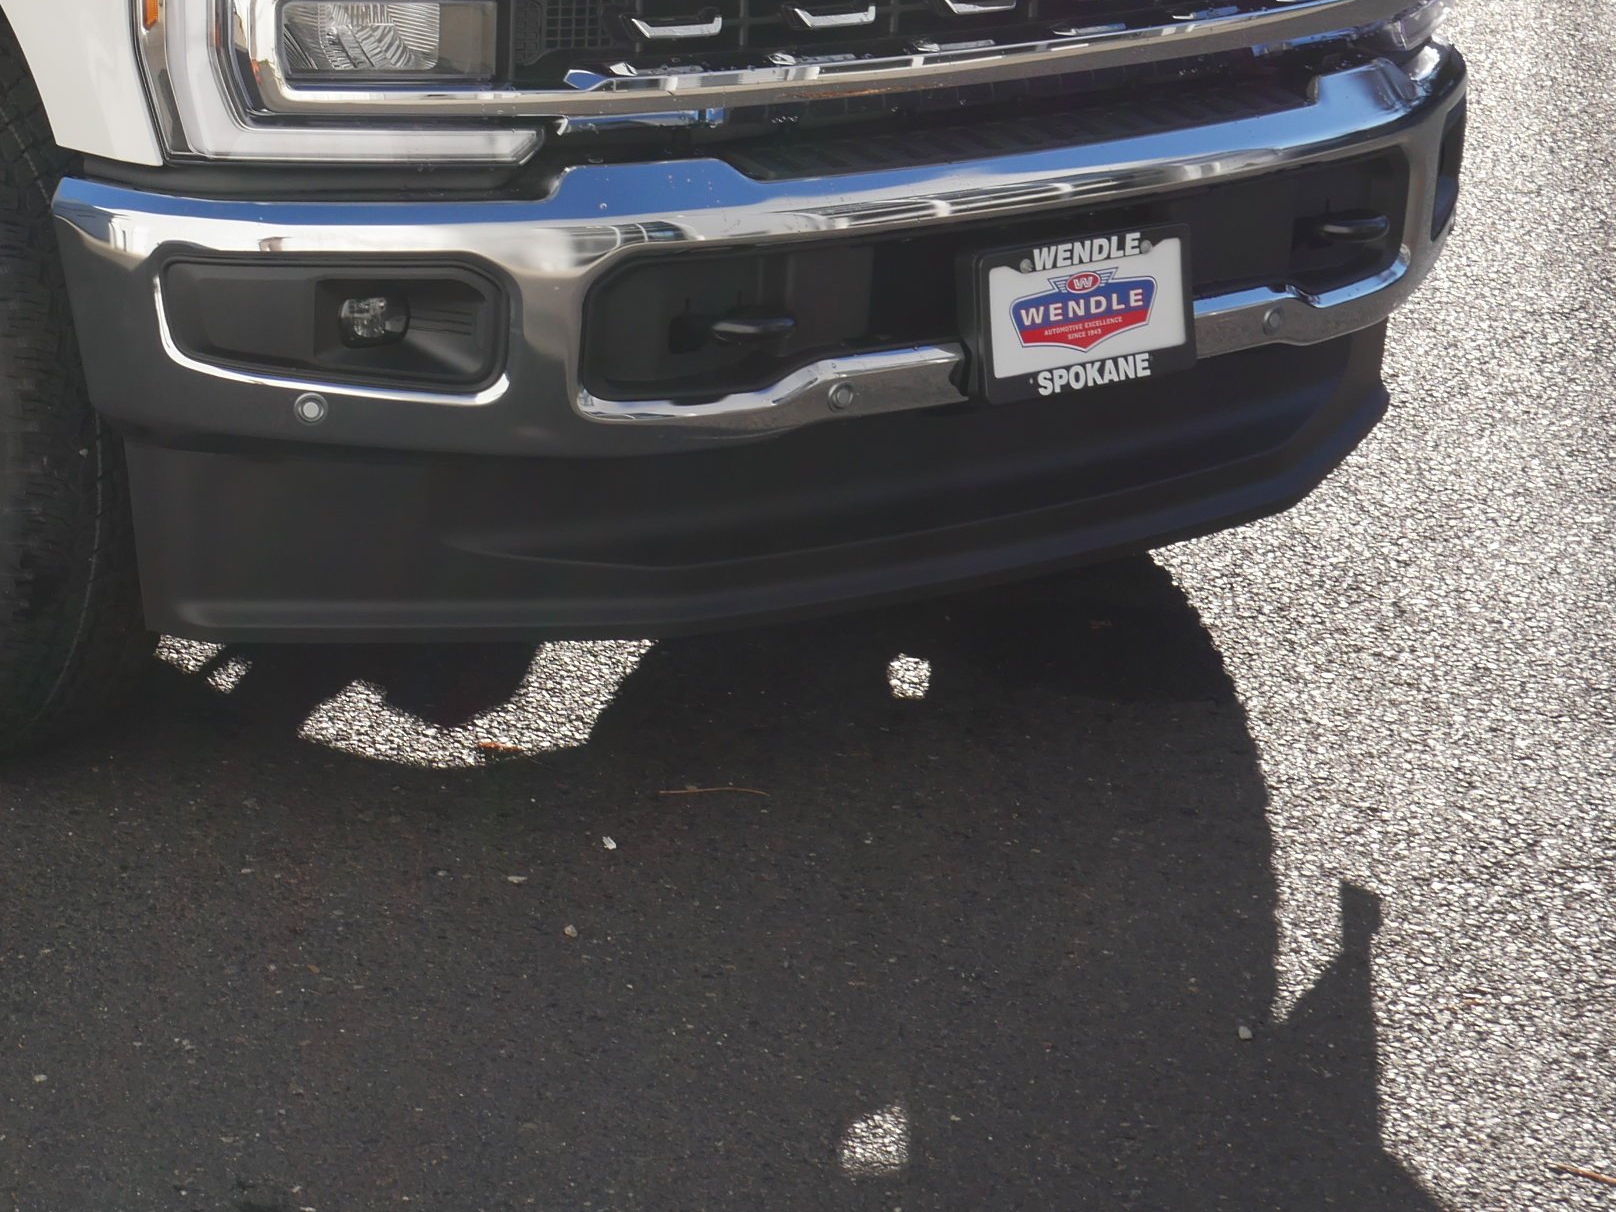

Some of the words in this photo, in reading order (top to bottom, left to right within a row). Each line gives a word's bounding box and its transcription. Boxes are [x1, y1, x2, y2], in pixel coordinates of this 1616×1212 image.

[1033, 232, 1141, 271] WENDLE
[1020, 289, 1144, 326] WENDLE
[1043, 322, 1084, 336] AUTOMOTIVE
[1084, 316, 1123, 329] EXCELLENCE
[1067, 330, 1087, 340] SINCE
[1087, 328, 1102, 337] 1943
[1037, 352, 1152, 397] SPOKANE
